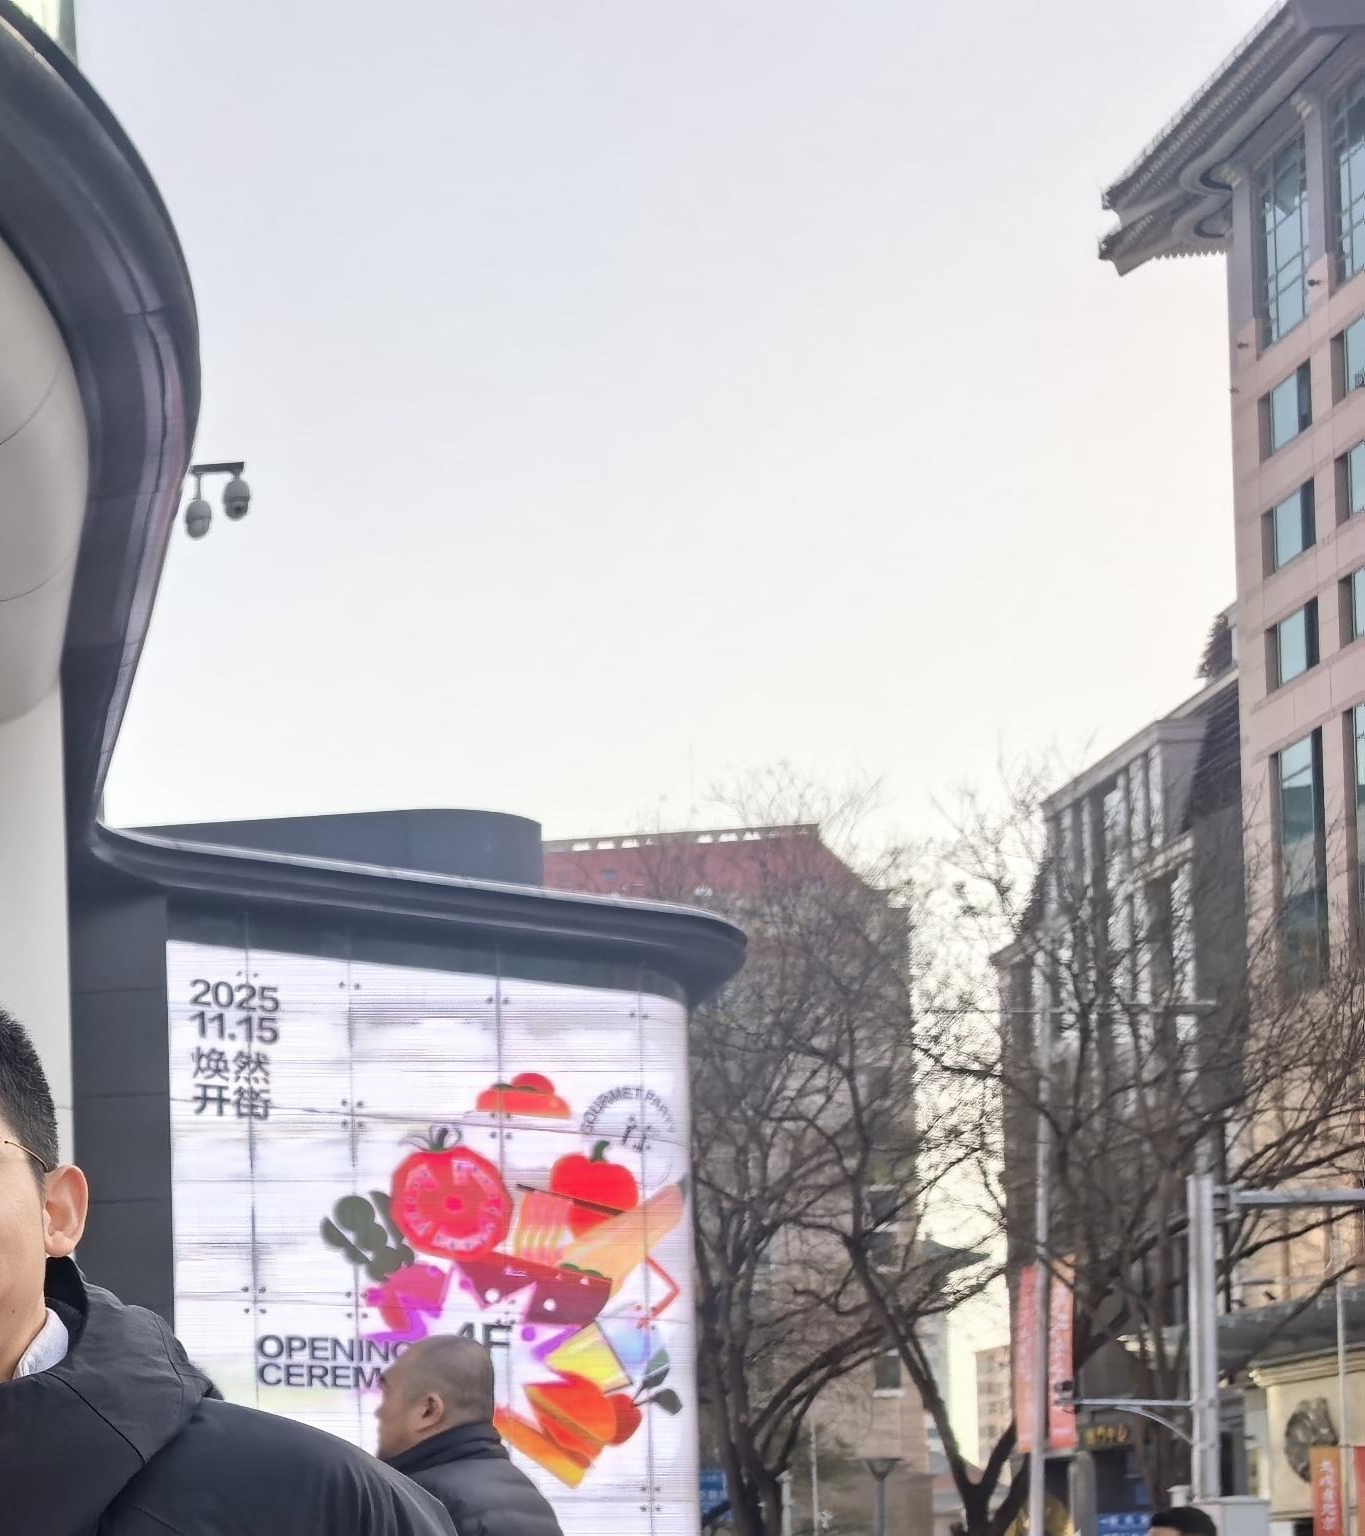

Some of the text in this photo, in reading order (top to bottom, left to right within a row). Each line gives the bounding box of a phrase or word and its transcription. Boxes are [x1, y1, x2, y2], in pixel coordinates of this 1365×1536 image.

[189, 978, 280, 1013] 2025
[189, 1011, 280, 1045] 11.15
[191, 1046, 270, 1084] 焕然
[192, 1083, 271, 1120] 开街
